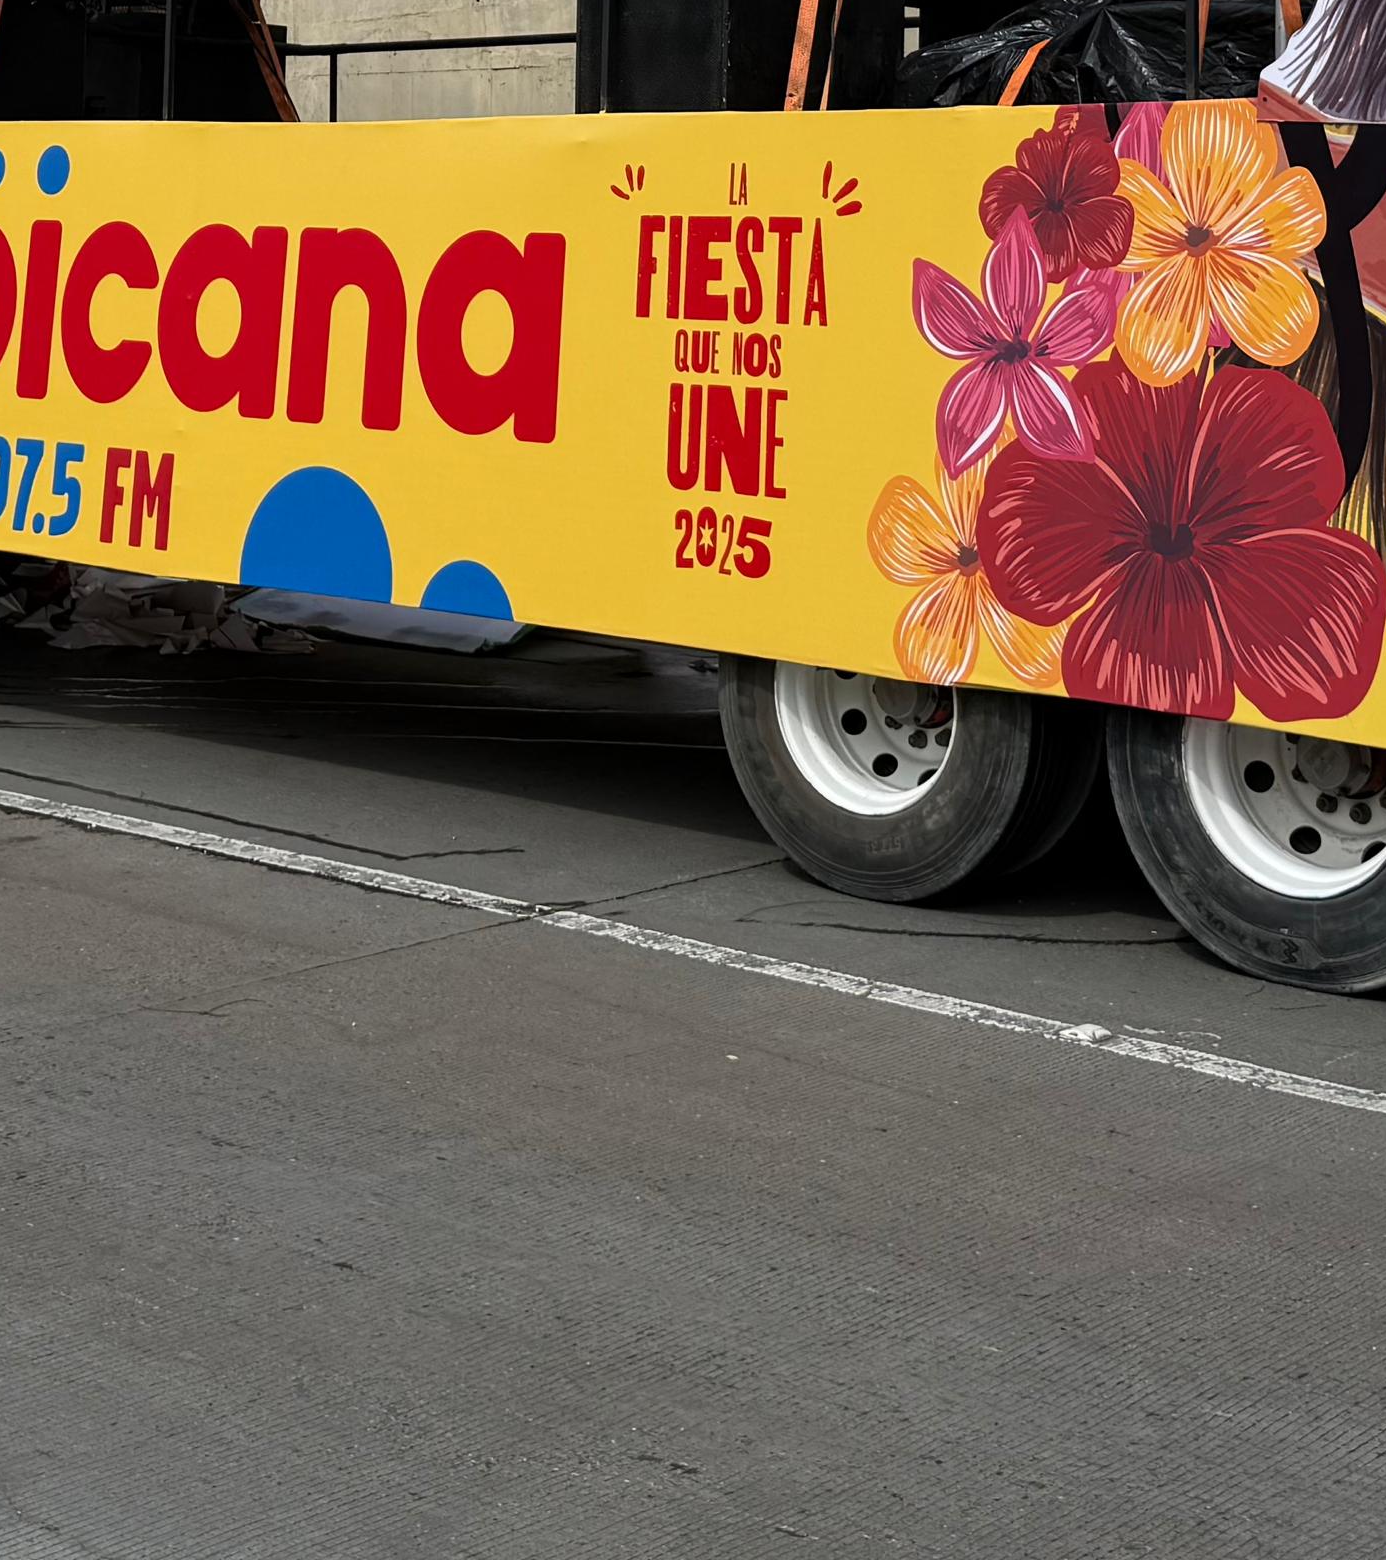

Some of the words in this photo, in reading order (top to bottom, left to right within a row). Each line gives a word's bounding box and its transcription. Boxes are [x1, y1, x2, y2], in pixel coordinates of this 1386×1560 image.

[728, 162, 748, 205] LA
[635, 215, 828, 326] FIESTA
[674, 328, 720, 374] QUE
[732, 331, 782, 378] NOS
[666, 383, 788, 499] UNE
[99, 446, 176, 551] FM
[674, 506, 773, 579] 2025
